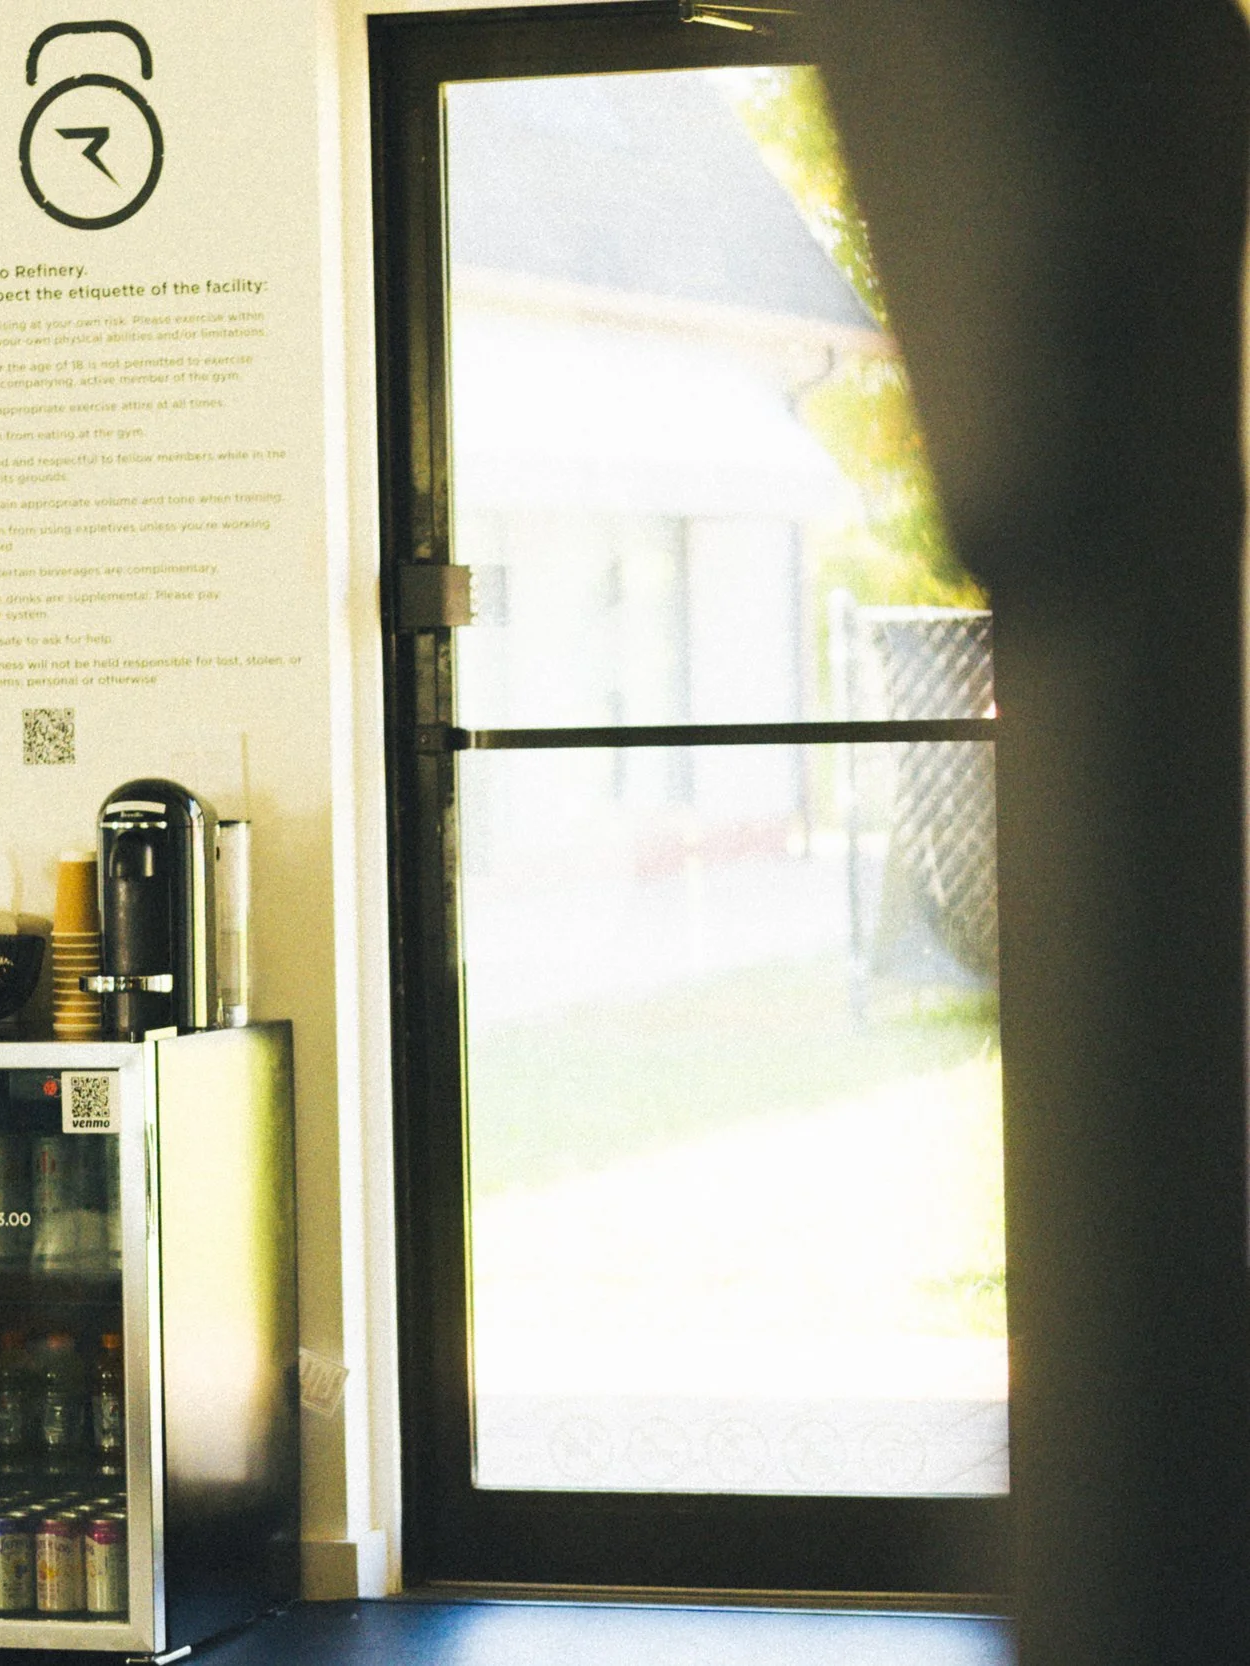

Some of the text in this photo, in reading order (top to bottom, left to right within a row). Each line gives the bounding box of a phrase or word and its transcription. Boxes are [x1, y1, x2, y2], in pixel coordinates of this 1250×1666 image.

[16, 264, 88, 279] Refinery.
[37, 287, 62, 300] the
[69, 285, 145, 300] etiquette
[151, 282, 167, 296] of
[173, 282, 200, 294] the
[30, 320, 42, 330] at
[46, 320, 71, 331] your
[76, 319, 100, 328] own
[132, 315, 171, 325] Please
[228, 312, 264, 321] within
[26, 337, 51, 345] own
[54, 334, 102, 346] physical
[8, 363, 26, 372] the
[29, 363, 52, 373] age
[56, 360, 68, 371] of
[88, 360, 97, 369] is
[100, 359, 120, 369] not
[124, 357, 184, 369] permitted
[187, 357, 200, 366] to
[80, 376, 115, 385] active
[119, 374, 168, 384] member
[173, 372, 185, 382] of
[189, 372, 209, 381] the
[121, 401, 153, 410] attire
[157, 400, 168, 409] at
[172, 400, 186, 409] all
[5, 431, 34, 440] from
[37, 430, 75, 441] eating
[78, 429, 89, 439] at
[94, 429, 113, 438] the
[12, 457, 34, 467] and
[101, 455, 113, 464] to
[117, 453, 152, 463] fellow
[218, 450, 248, 460] while
[252, 450, 263, 460] in
[267, 449, 286, 459] the
[1, 475, 14, 484] its
[20, 498, 90, 510] appropriate
[94, 497, 137, 506] volume
[141, 496, 164, 506] and
[199, 495, 231, 504] when
[8, 525, 36, 535] from
[40, 525, 71, 536] using
[139, 521, 177, 532] unless
[222, 519, 270, 531] working
[39, 566, 99, 578] beverages
[104, 567, 121, 576] are
[5, 594, 41, 604] drinks
[46, 594, 63, 603] are
[155, 590, 193, 600] Please
[198, 591, 220, 601] pay
[25, 636, 39, 646] to
[42, 635, 62, 645] ask
[65, 634, 81, 644] for
[28, 659, 48, 670] will
[51, 659, 70, 670] not
[74, 658, 89, 669] be
[93, 657, 119, 668] held
[122, 656, 192, 669] responsible
[196, 656, 212, 666] for
[288, 655, 301, 665] or
[27, 676, 78, 688] personal
[82, 677, 93, 686] or
[72, 1118, 111, 1129] venmo
